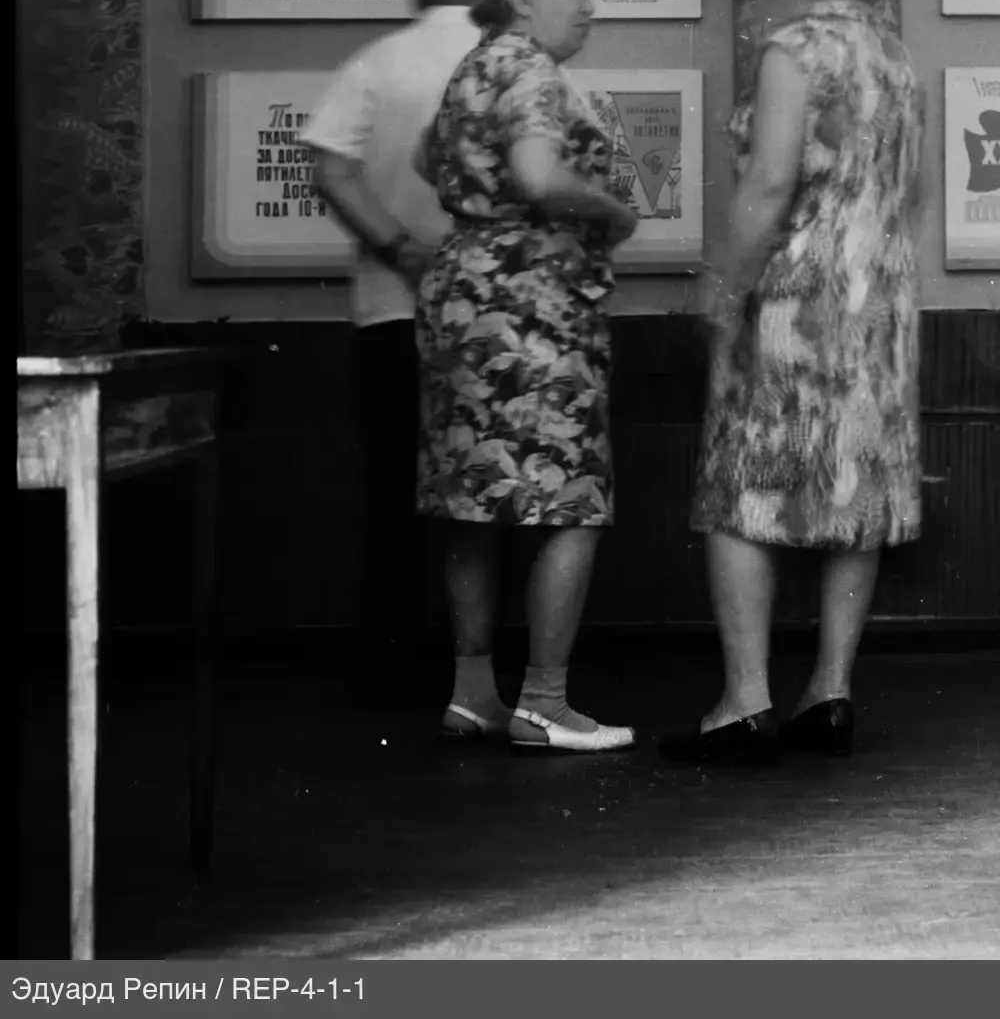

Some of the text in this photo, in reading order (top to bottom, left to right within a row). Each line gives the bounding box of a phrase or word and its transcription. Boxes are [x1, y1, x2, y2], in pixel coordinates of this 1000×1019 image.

[257, 148, 272, 163] ЗА
[256, 166, 314, 181] ПЯТИЛЕТ
[256, 201, 289, 217] ГОДА
